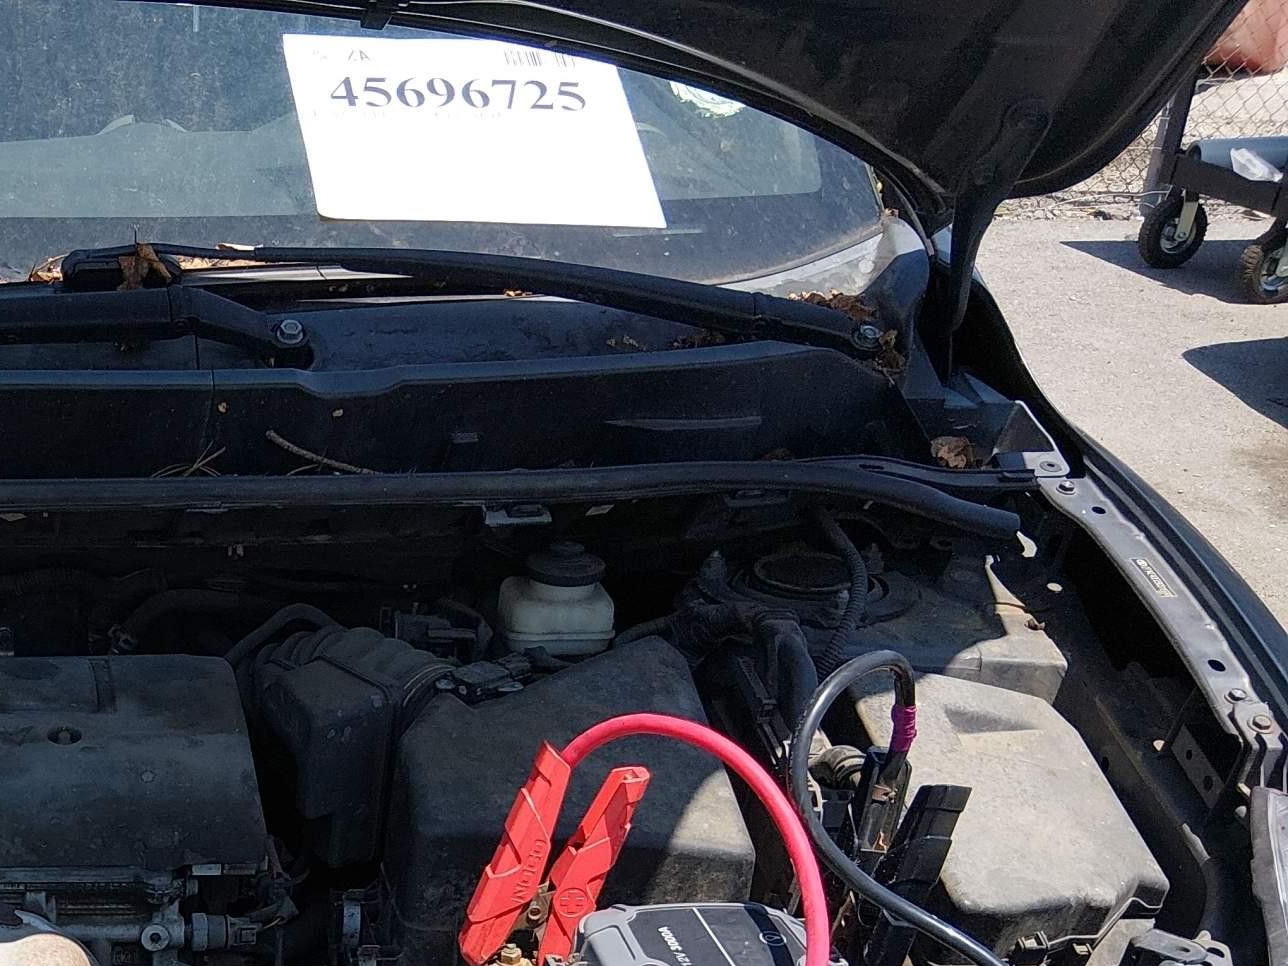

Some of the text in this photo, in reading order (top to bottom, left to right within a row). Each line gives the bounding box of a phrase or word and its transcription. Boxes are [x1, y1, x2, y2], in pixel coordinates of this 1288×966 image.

[329, 76, 587, 112] 45696725
[657, 926, 693, 966] 12V 3000A
